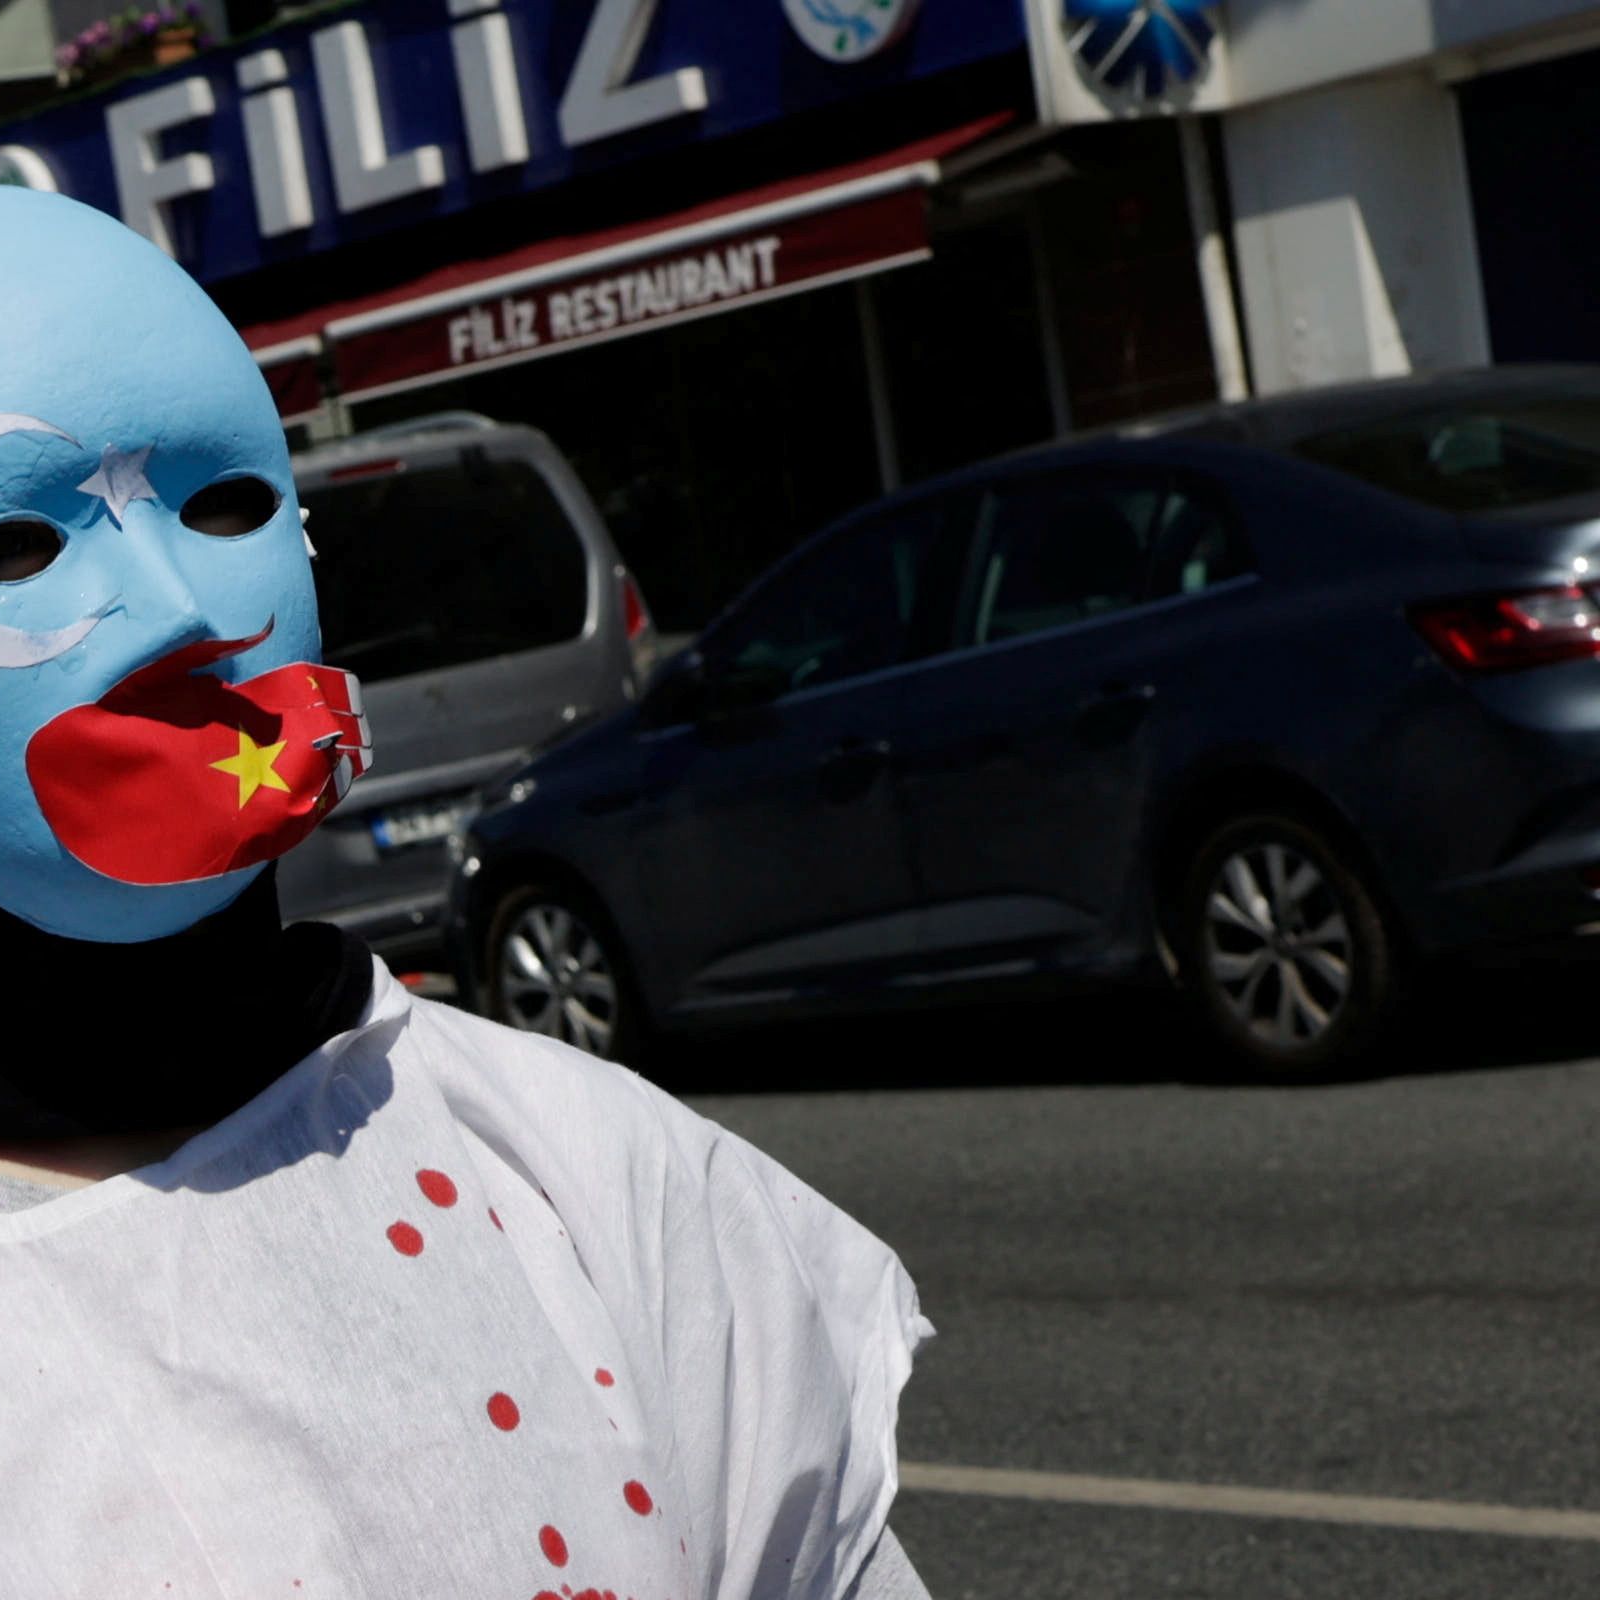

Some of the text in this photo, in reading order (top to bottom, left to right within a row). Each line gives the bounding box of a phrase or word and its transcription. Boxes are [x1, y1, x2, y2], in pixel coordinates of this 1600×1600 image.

[104, 0, 709, 260] FİLİZ
[448, 236, 782, 364] FİLİZ RESTAURANT
